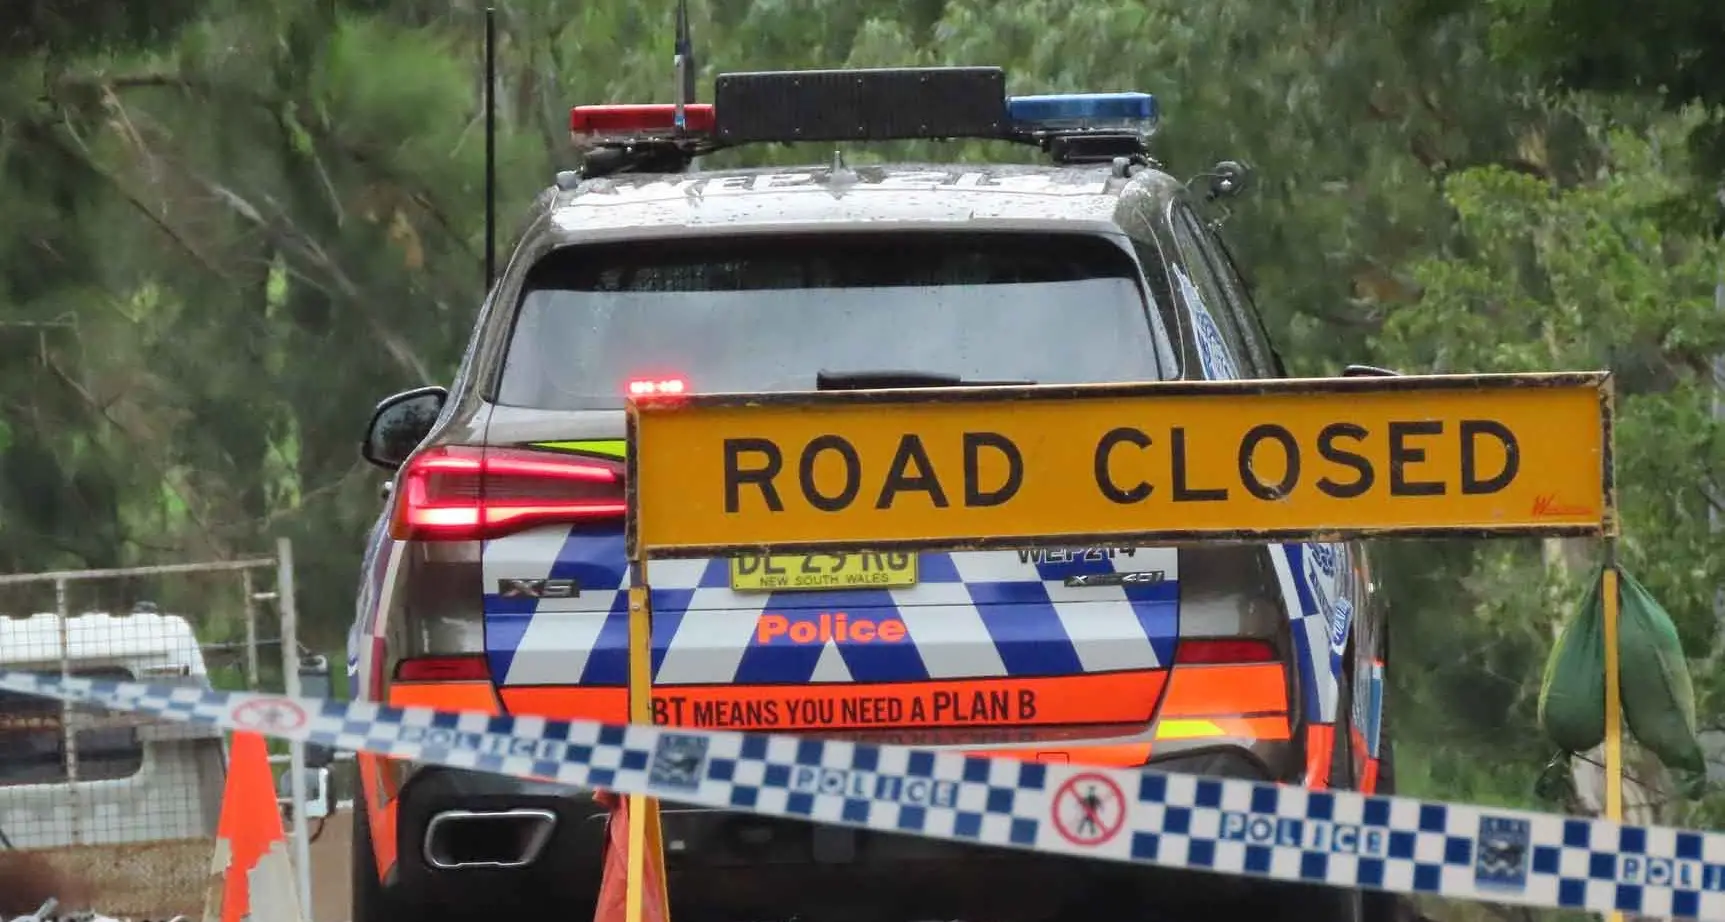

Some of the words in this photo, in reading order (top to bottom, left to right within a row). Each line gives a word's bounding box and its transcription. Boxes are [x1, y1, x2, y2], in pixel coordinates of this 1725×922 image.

[723, 431, 1024, 513] ROAD
[1094, 420, 1520, 505] CLOSED
[760, 575, 788, 587] NEW
[795, 574, 839, 586] SOUTH
[847, 572, 889, 583] WALES
[758, 613, 906, 644] Police
[651, 696, 686, 727] BT
[694, 700, 778, 727] MEANS
[786, 698, 833, 725] YOU
[841, 698, 902, 724] NEED
[911, 696, 925, 721] A
[933, 689, 1008, 721] PLAN
[1018, 689, 1036, 720] B
[797, 768, 951, 804] POLICE
[1223, 812, 1382, 855] POLICE
